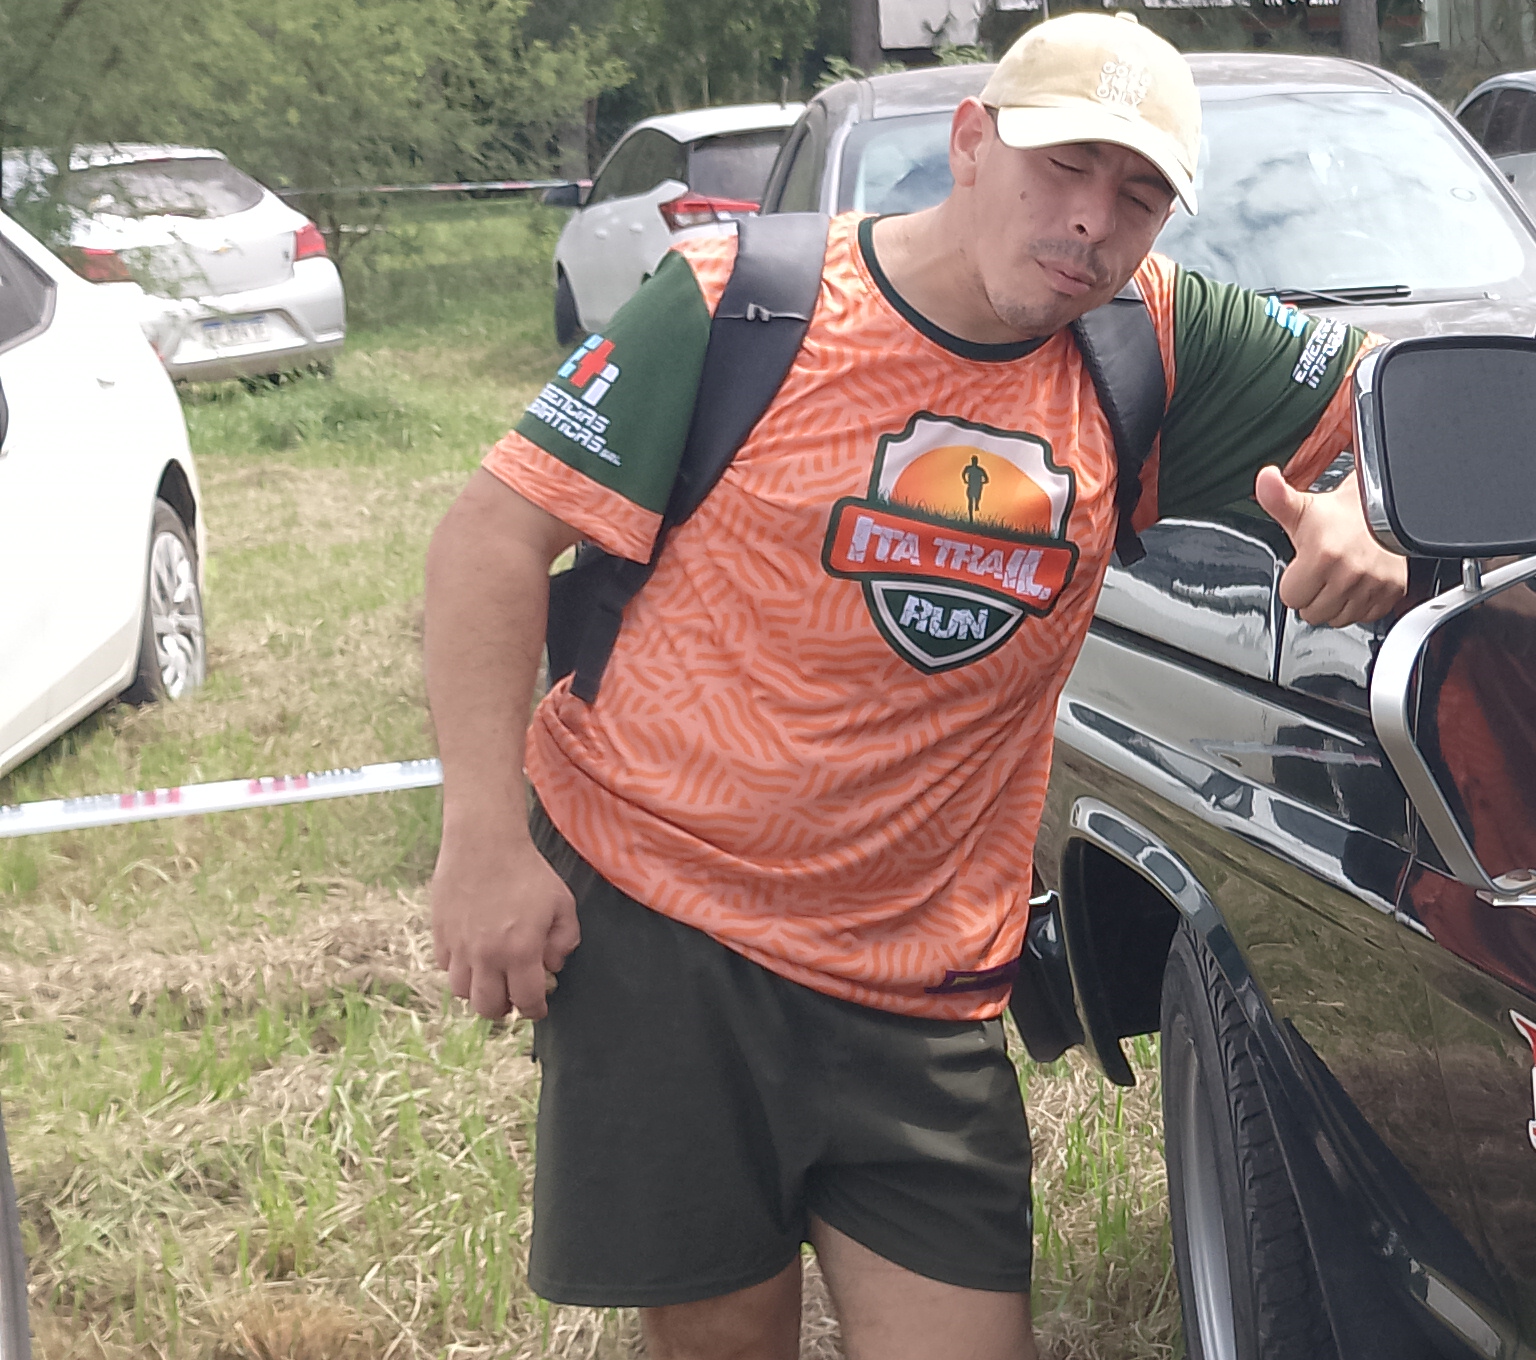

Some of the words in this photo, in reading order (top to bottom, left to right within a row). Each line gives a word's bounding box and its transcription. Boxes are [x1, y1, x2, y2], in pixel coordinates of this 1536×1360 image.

[847, 514, 921, 566] ITA
[933, 537, 1052, 601] TRAIL
[899, 594, 989, 640] RUN
